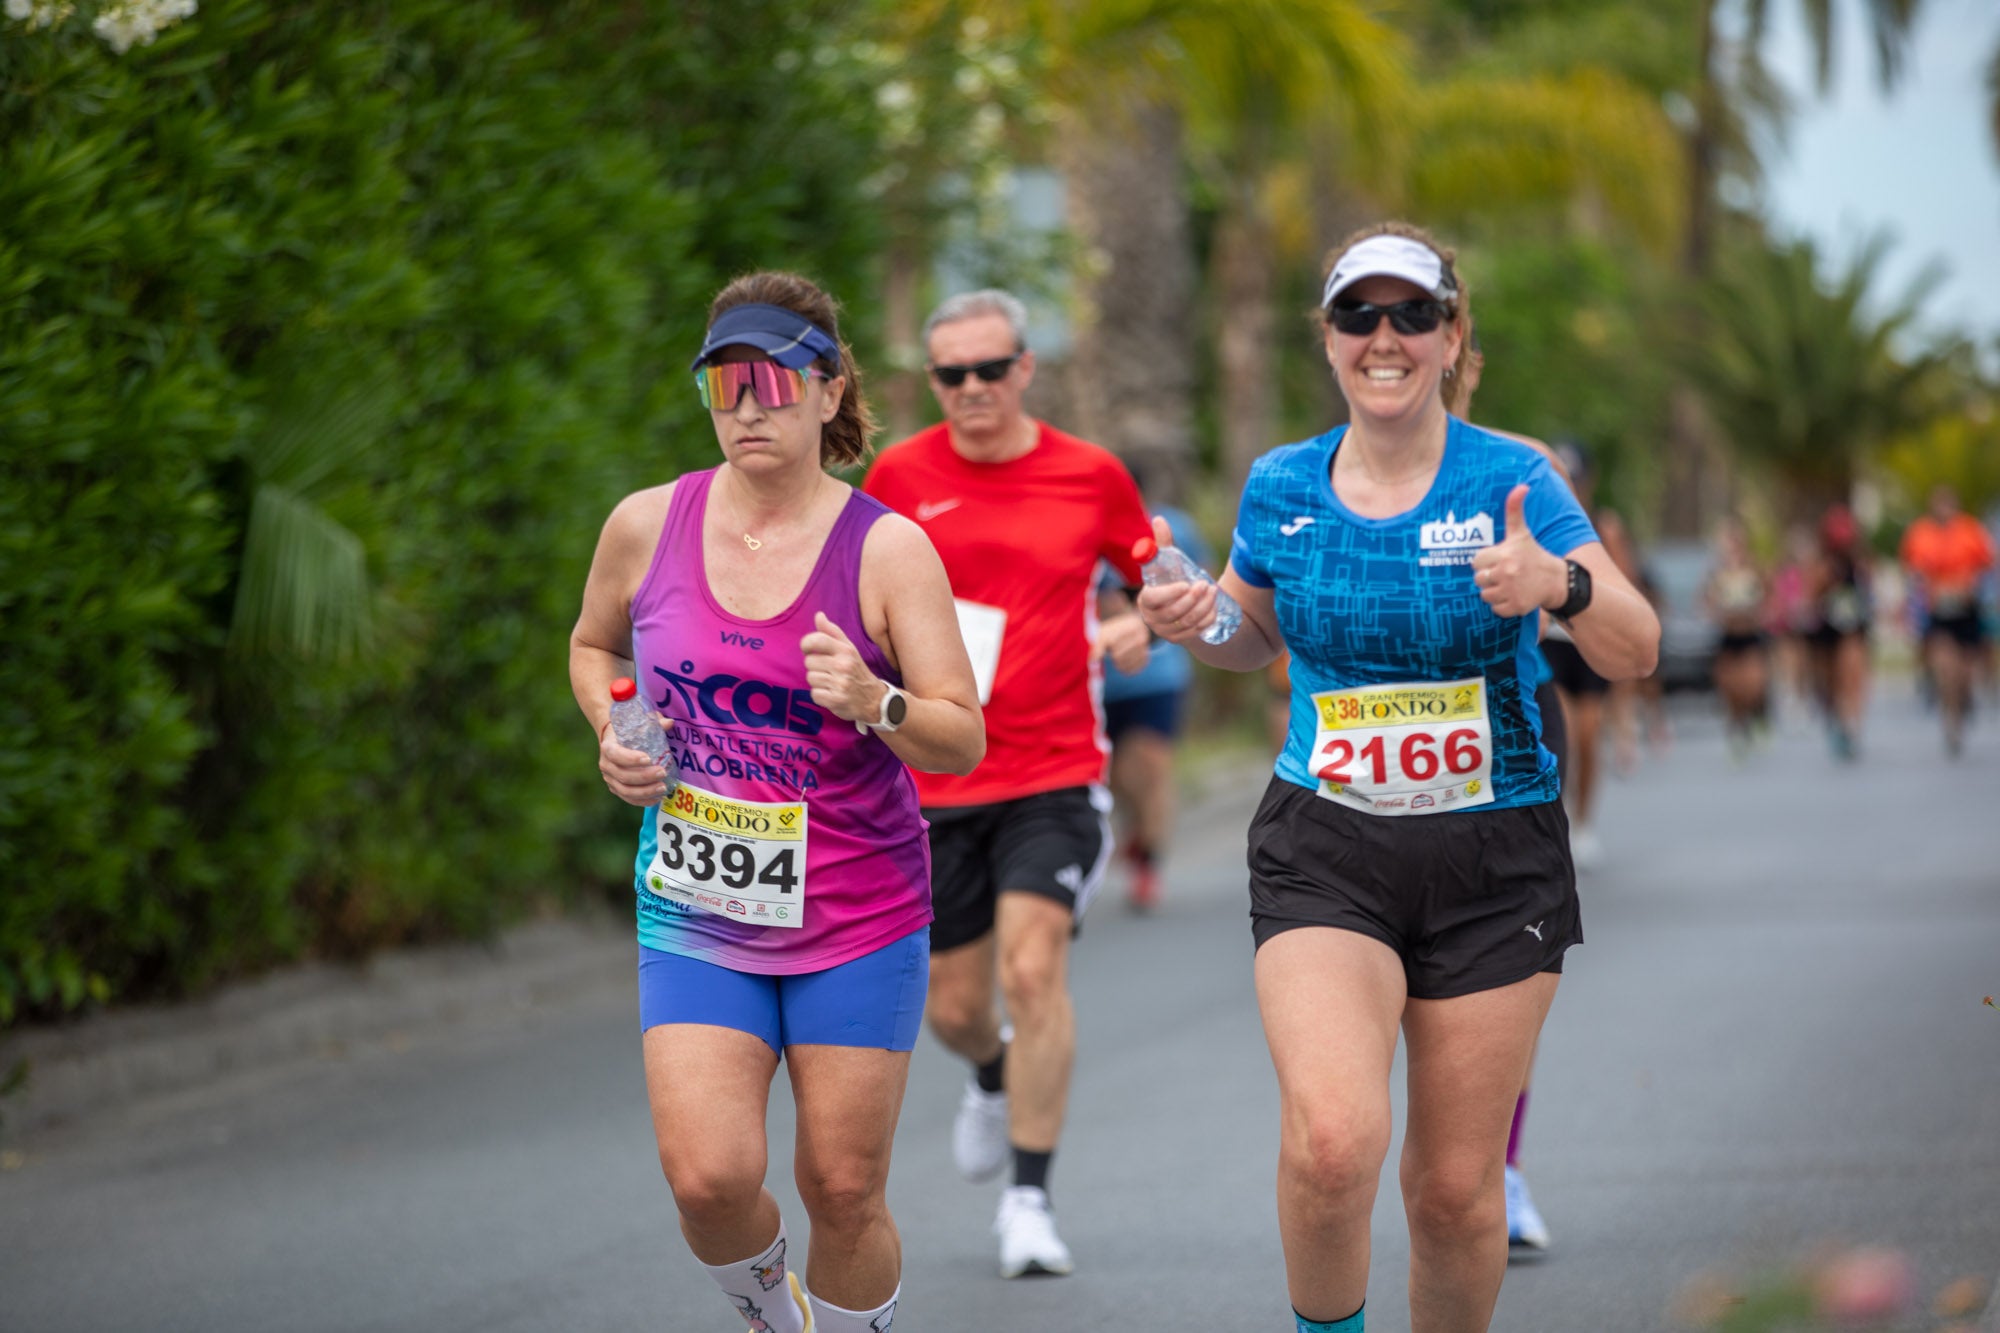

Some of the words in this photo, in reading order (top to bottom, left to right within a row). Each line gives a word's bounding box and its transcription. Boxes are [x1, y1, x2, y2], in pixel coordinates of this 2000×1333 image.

[1431, 527, 1484, 543] LOJA
[720, 631, 764, 650] vive
[1338, 697, 1360, 720] 38
[1363, 694, 1392, 703] GRAN
[1395, 692, 1436, 700] PREMIO
[1360, 699, 1447, 720] FONDO
[706, 733, 822, 765] ATLETISMO
[1317, 728, 1483, 785] 2166
[674, 788, 694, 814] 38
[699, 795, 722, 810] GRAN
[724, 803, 763, 818] PREMIO
[693, 802, 770, 833] FONDO
[661, 822, 798, 894] 3394
